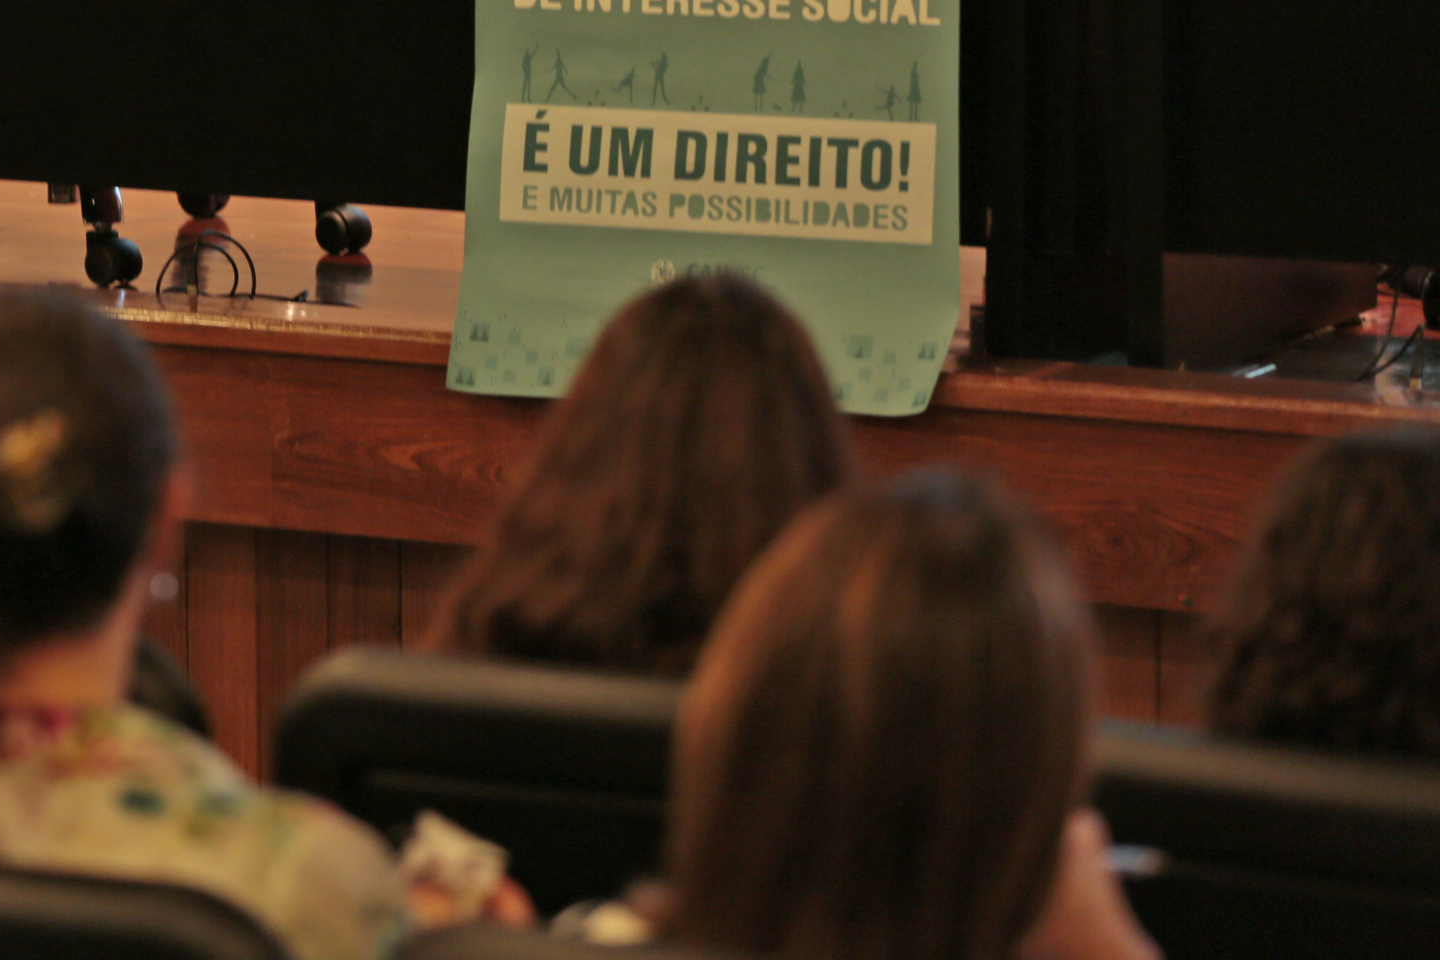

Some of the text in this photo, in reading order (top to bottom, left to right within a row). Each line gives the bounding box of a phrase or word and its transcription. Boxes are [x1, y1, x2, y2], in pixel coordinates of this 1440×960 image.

[522, 109, 911, 192] É UM DIREITO!
[522, 185, 909, 231] E MUITAS POSSIBILIDADES
